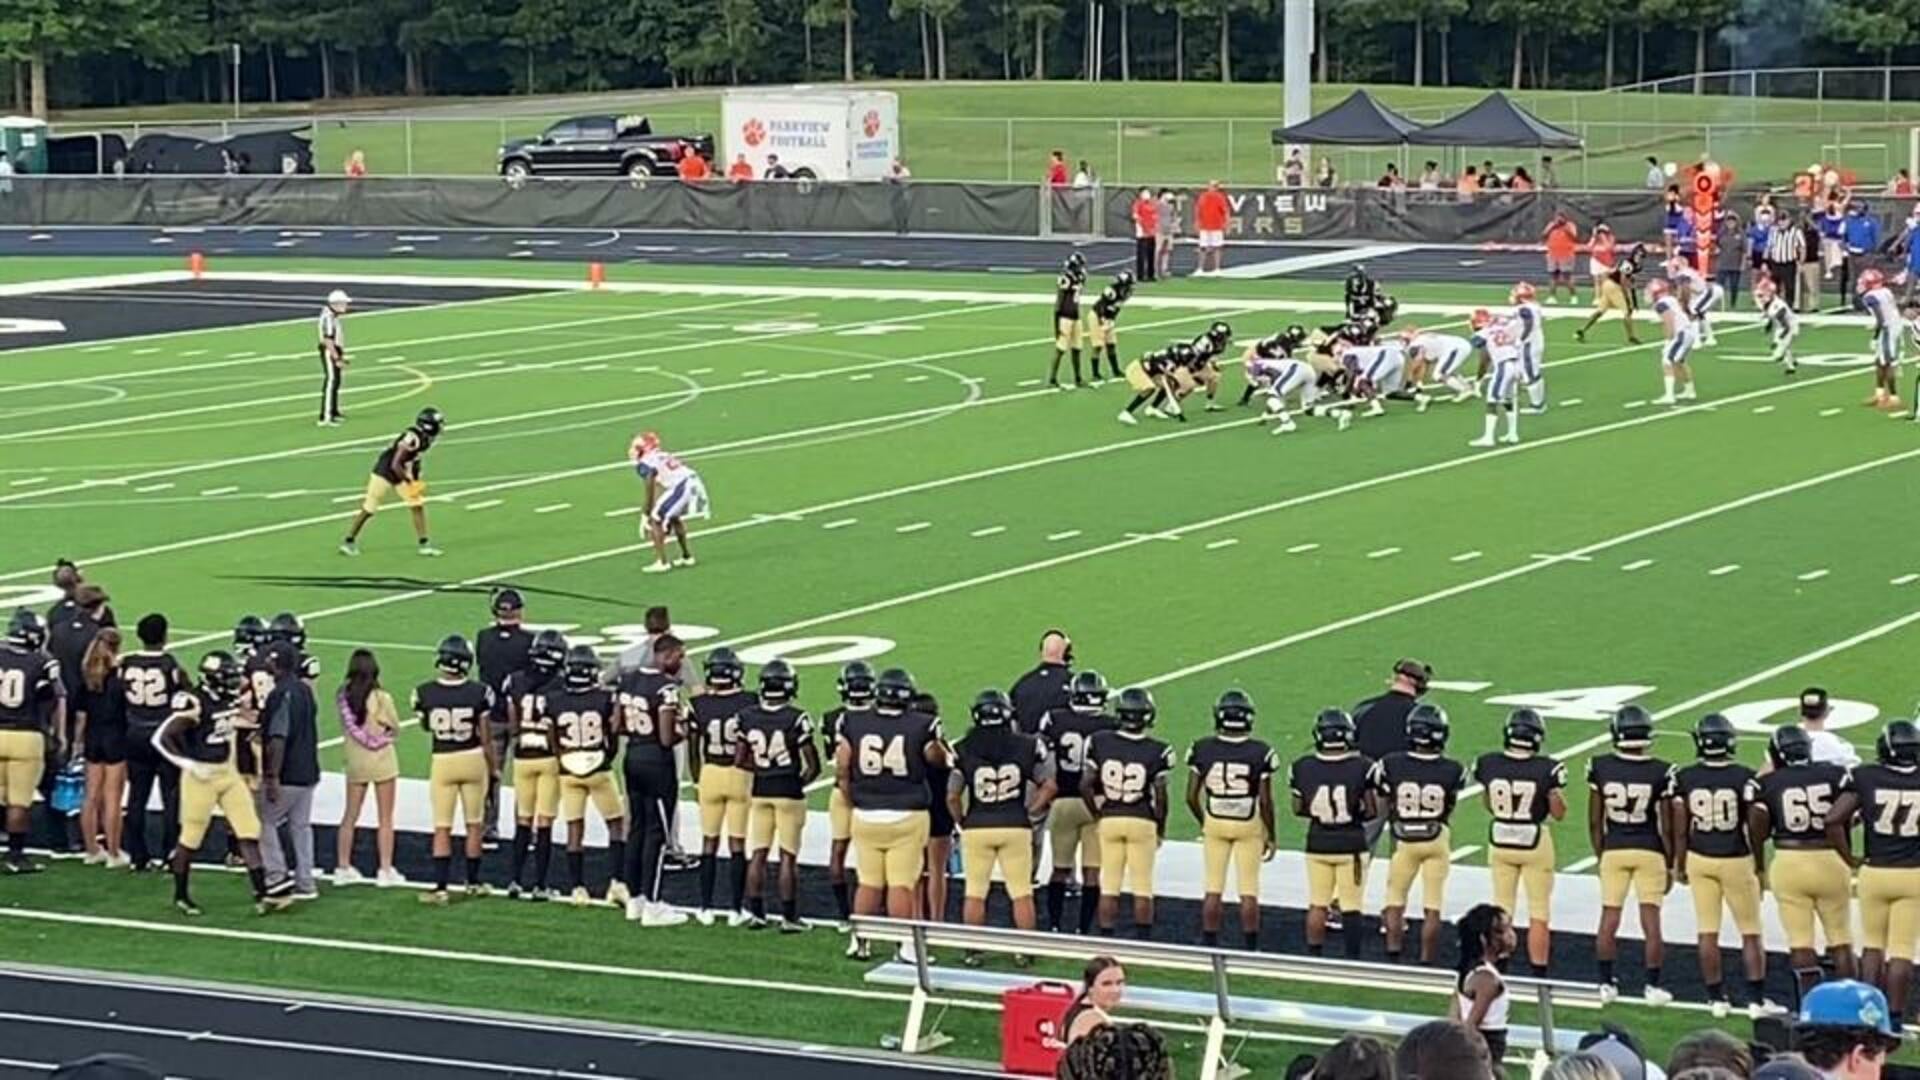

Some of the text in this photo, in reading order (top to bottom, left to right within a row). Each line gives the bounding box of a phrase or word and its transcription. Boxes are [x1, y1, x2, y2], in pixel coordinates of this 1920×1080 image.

[124, 667, 169, 706] 32
[557, 711, 603, 749] 38
[858, 733, 908, 776] 64
[973, 763, 1021, 803] 62
[1100, 759, 1147, 803] 92
[1205, 761, 1250, 796] 45
[1309, 784, 1351, 824] 41
[1396, 781, 1446, 819] 89
[1488, 778, 1537, 821] 87
[1603, 782, 1653, 823] 27
[1689, 788, 1739, 832] 90
[1781, 782, 1833, 832] 65
